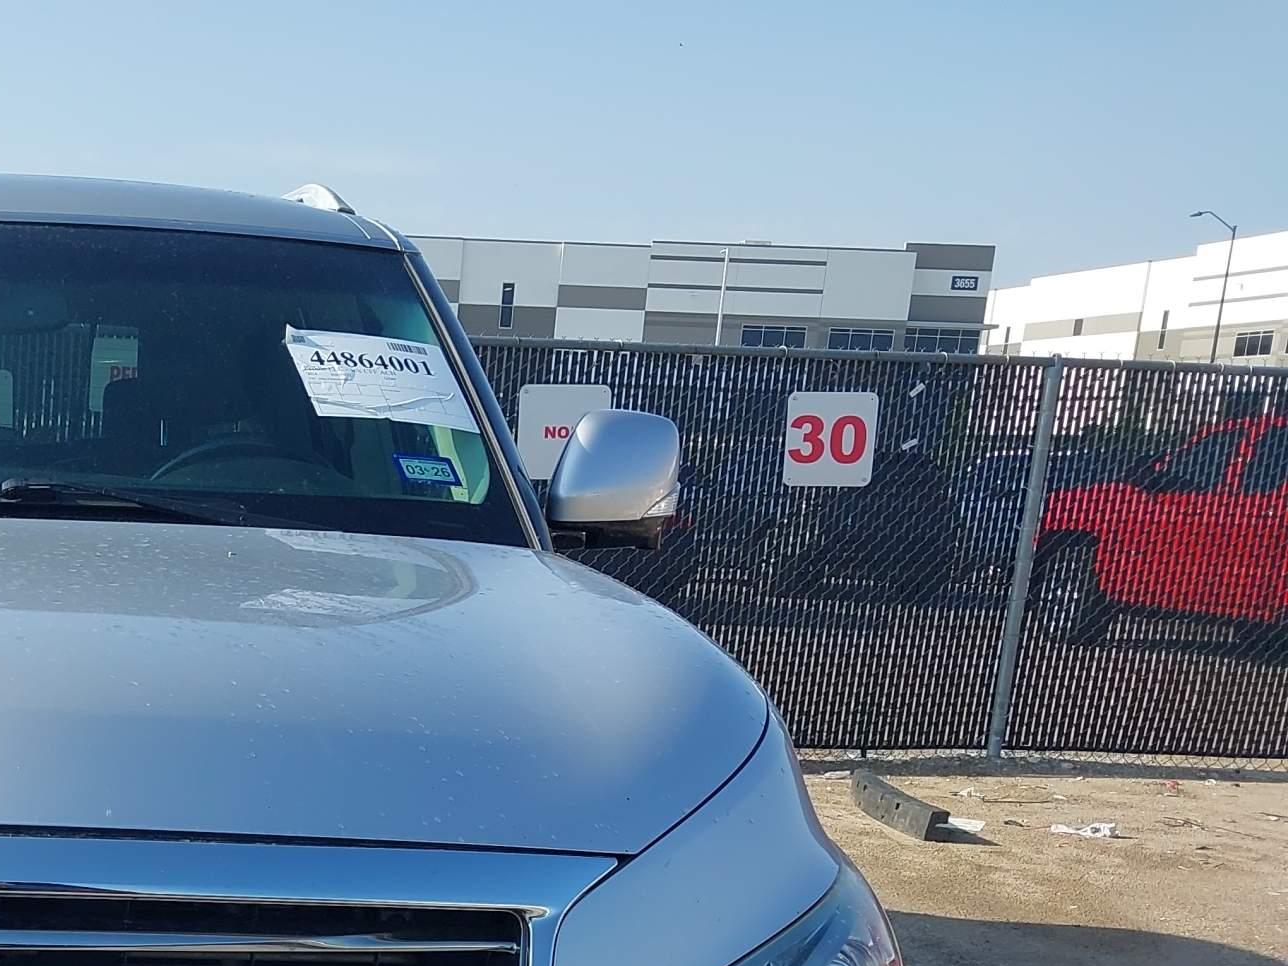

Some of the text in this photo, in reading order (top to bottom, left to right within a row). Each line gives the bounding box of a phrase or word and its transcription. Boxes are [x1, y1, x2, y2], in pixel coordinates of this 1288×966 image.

[954, 278, 976, 289] 3655
[310, 350, 435, 377] 44864001
[544, 426, 574, 439] NO
[787, 415, 867, 464] 30
